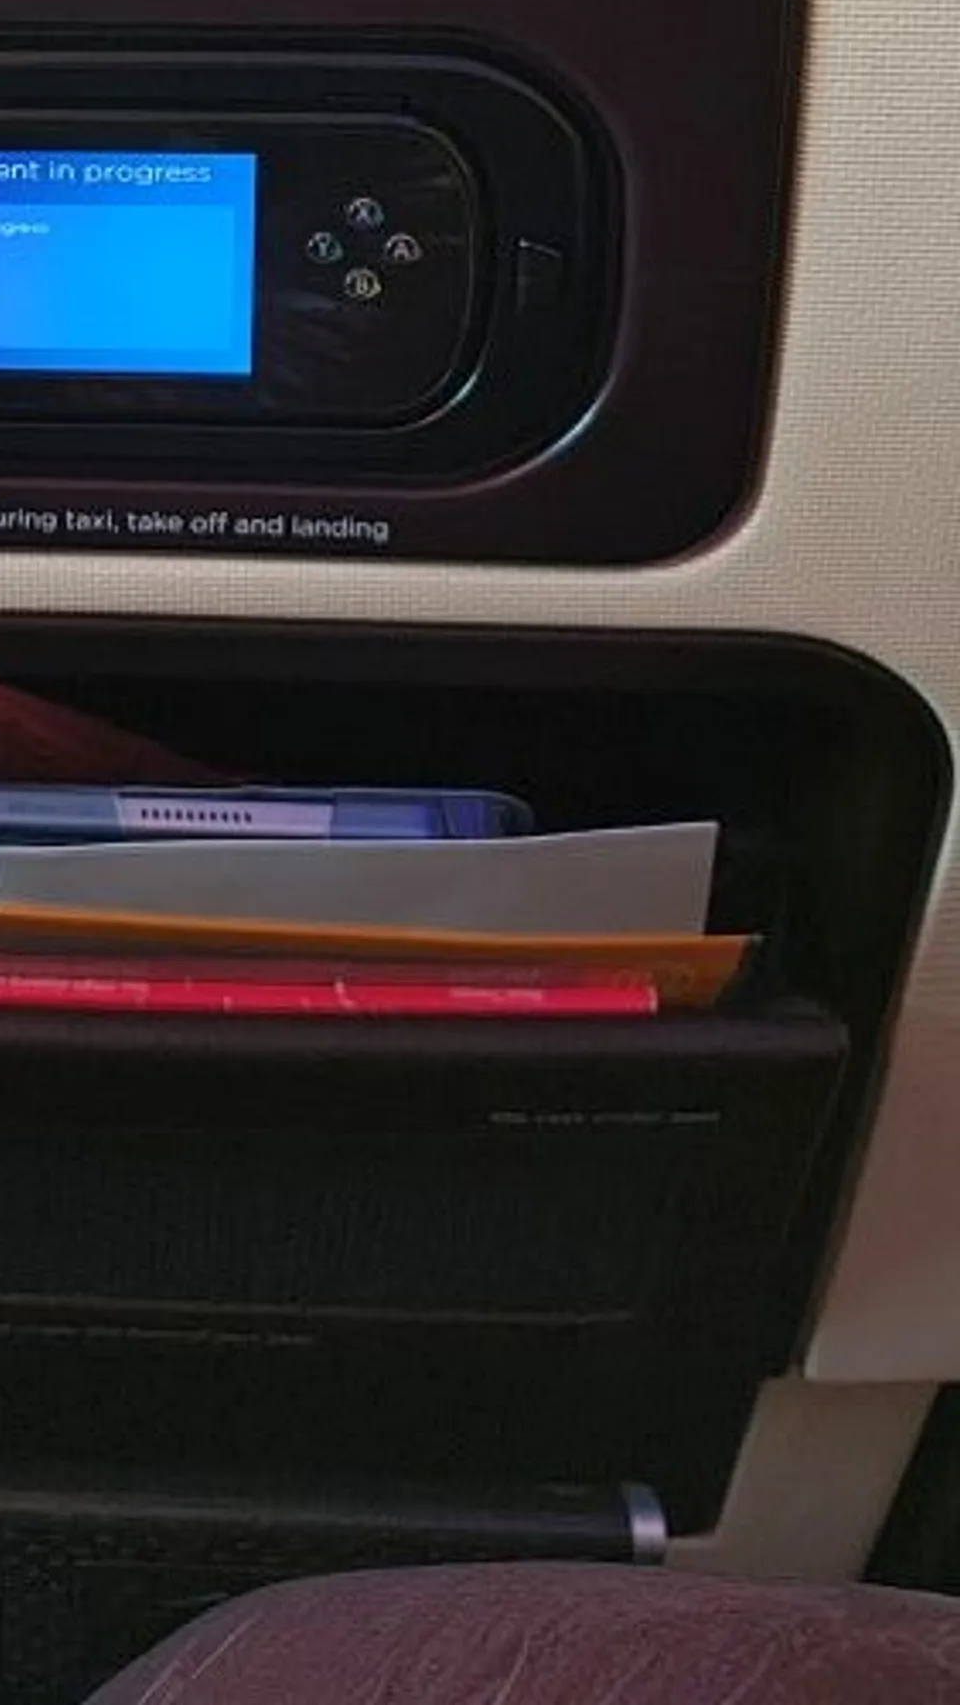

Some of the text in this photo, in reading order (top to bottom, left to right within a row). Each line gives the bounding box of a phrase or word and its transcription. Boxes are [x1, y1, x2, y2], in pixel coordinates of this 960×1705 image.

[48, 160, 76, 180] in
[82, 162, 212, 186] progress
[66, 508, 120, 534] taxi,
[127, 511, 185, 534] take
[190, 511, 229, 534] off
[234, 514, 285, 535] and
[292, 514, 389, 542] landing
